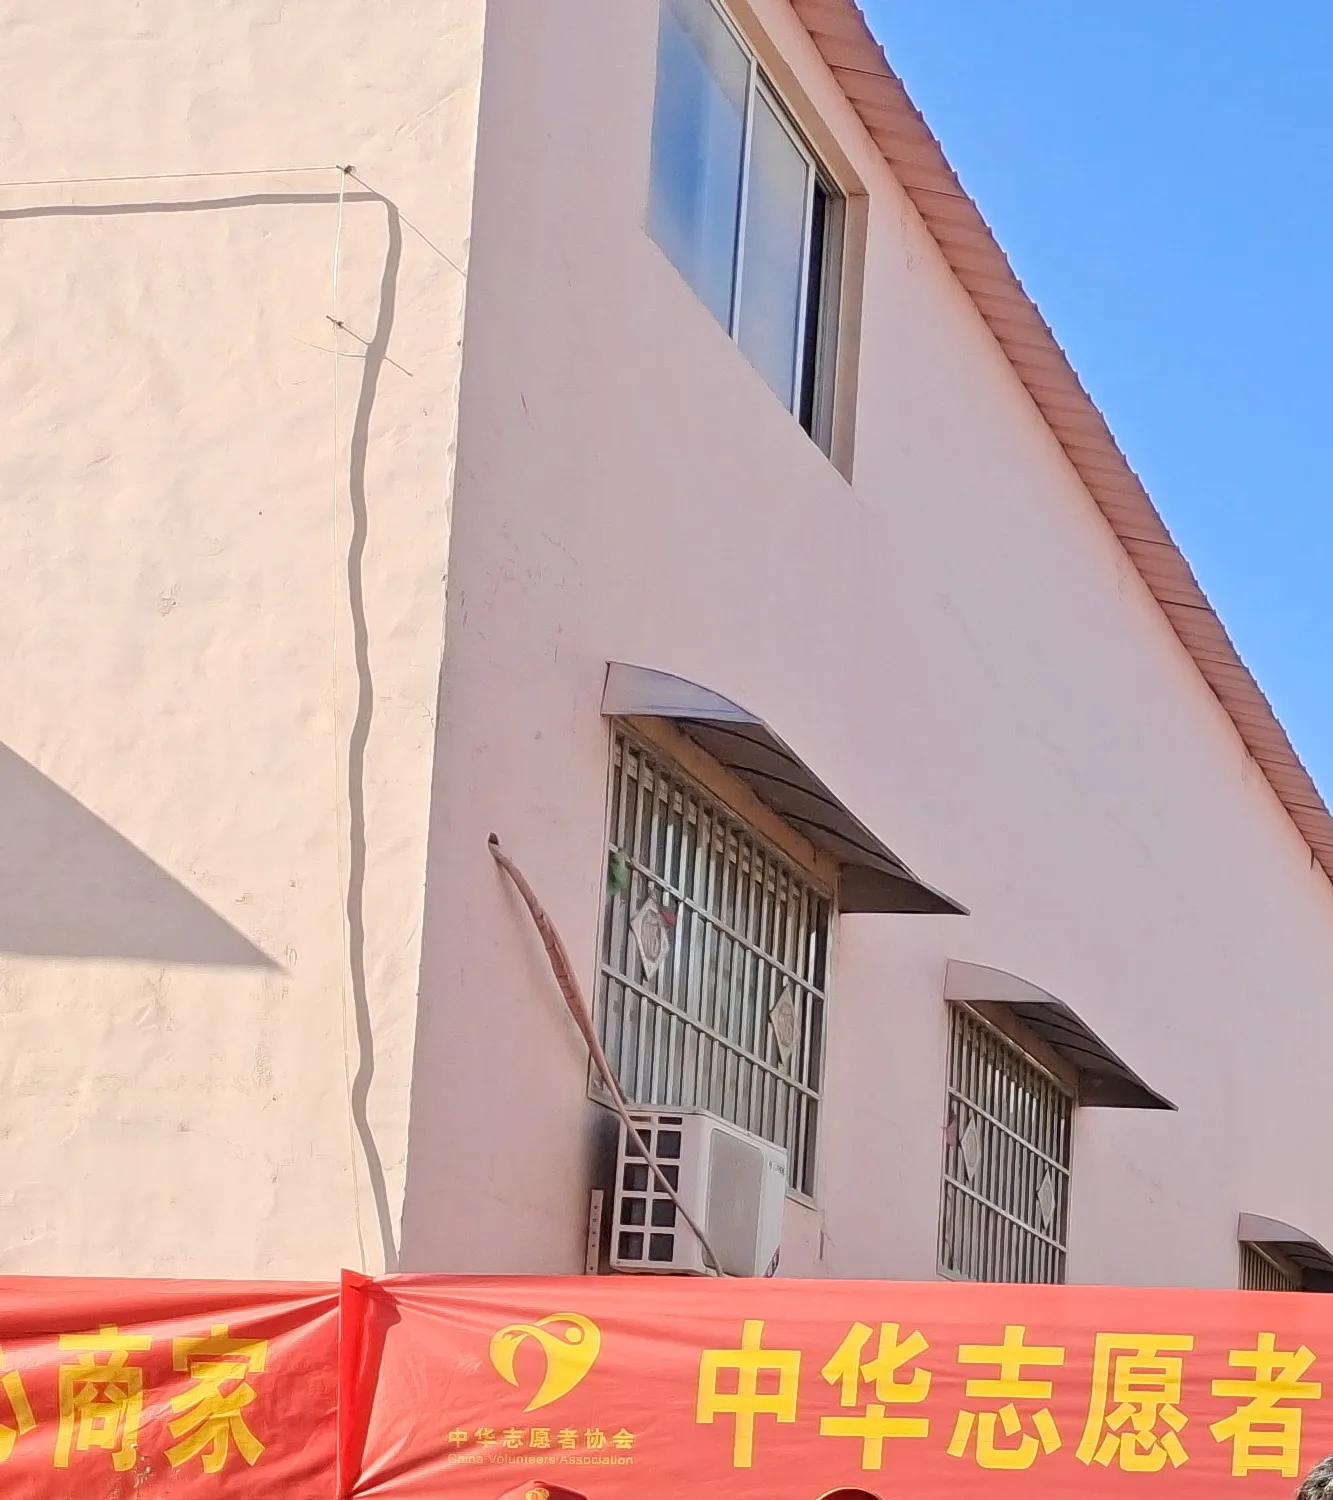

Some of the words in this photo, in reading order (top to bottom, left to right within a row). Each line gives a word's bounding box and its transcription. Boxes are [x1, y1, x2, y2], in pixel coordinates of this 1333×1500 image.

[447, 1426, 635, 1449] 中华志愿者协会
